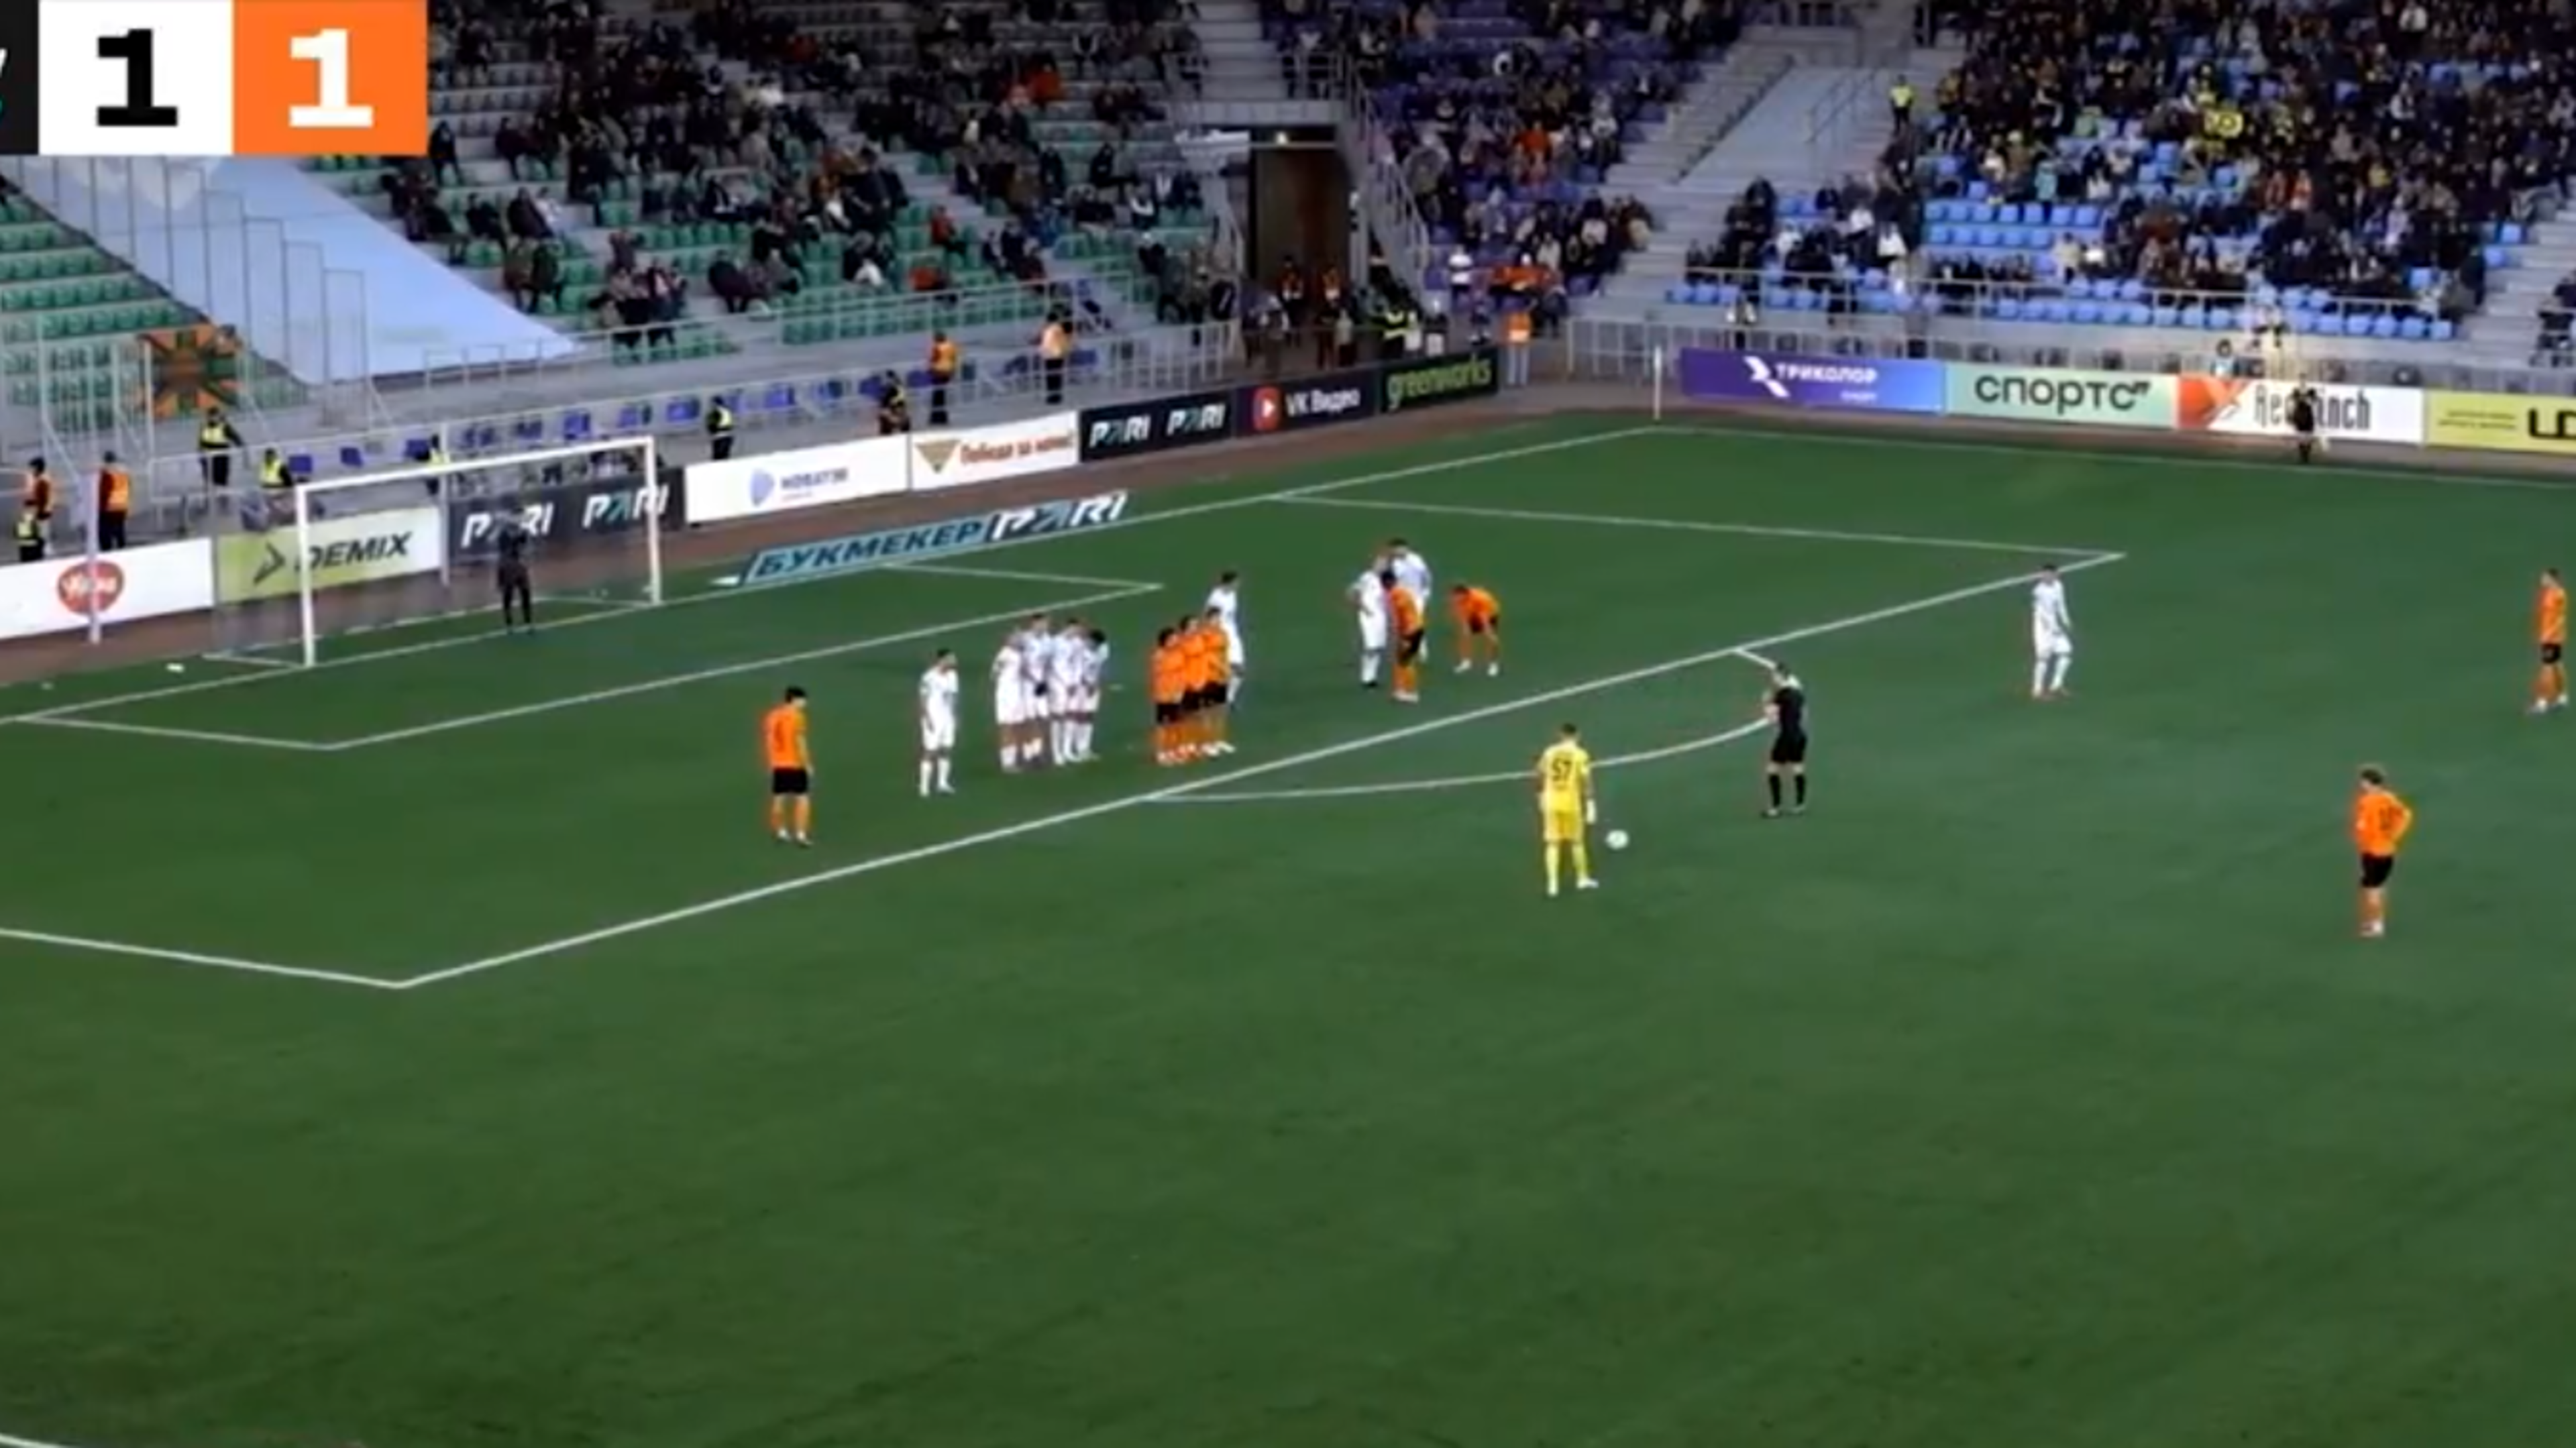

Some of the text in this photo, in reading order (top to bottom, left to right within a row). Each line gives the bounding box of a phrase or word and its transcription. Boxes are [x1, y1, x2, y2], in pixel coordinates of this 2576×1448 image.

[1388, 353, 1492, 410] greenworks
[1166, 404, 1226, 436] PARI
[1285, 388, 1360, 416] VK Видео
[1089, 414, 1150, 448] PARI
[461, 502, 554, 547] PRI
[757, 489, 1128, 577] БУКМЕКЕР PARI
